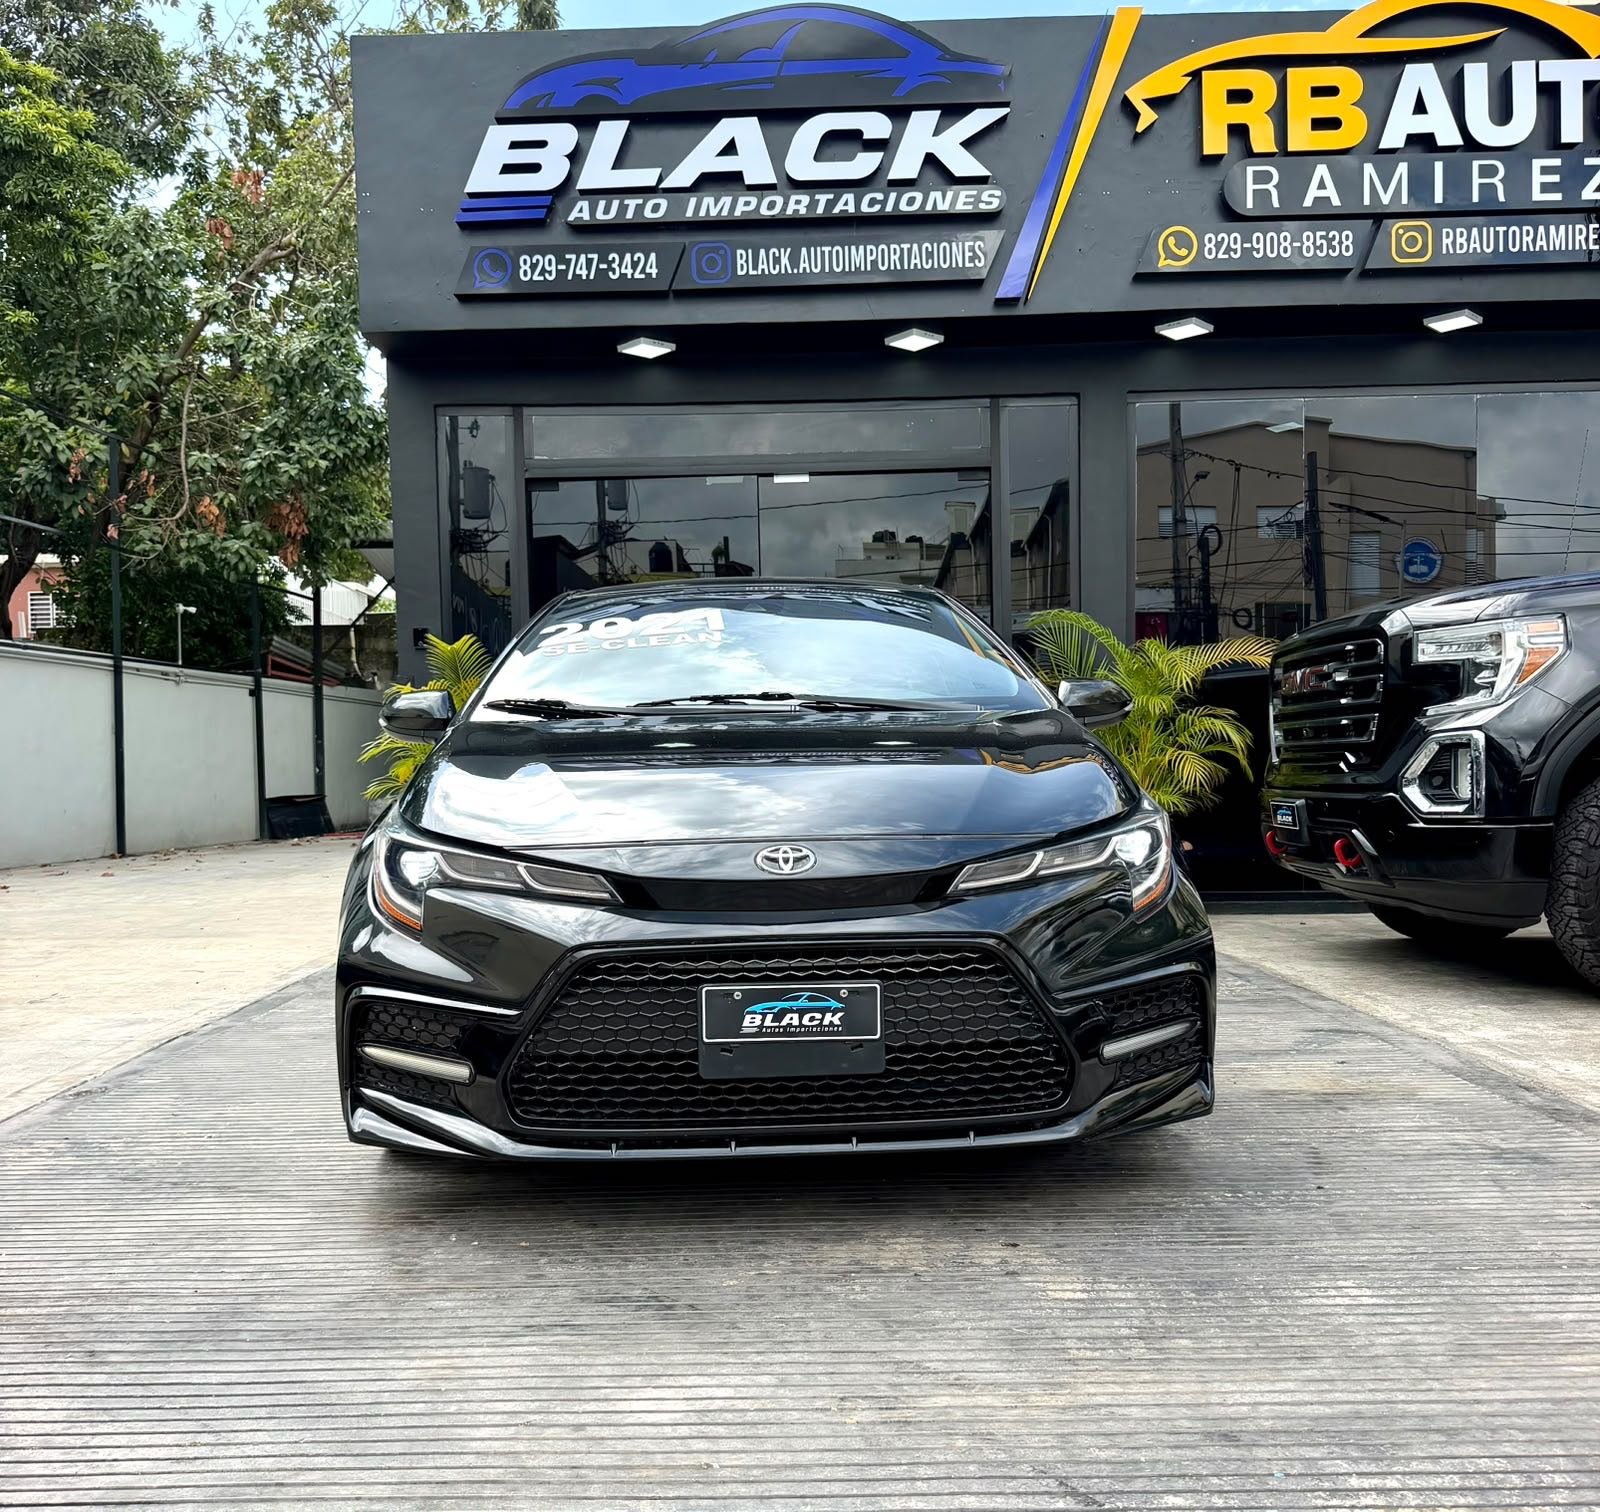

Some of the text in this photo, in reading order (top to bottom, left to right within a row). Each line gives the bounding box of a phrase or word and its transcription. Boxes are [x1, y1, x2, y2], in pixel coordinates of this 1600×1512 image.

[465, 107, 1011, 194] BLACK
[567, 189, 1003, 221] AUTO IMPORTACIONES
[736, 241, 986, 276] BLACK.AUTOIMPORTACIONES
[1204, 230, 1354, 260] 829-908-8538
[519, 252, 658, 281] 829-747-3424
[537, 608, 725, 648] 2021
[742, 1012, 845, 1027] BLACK
